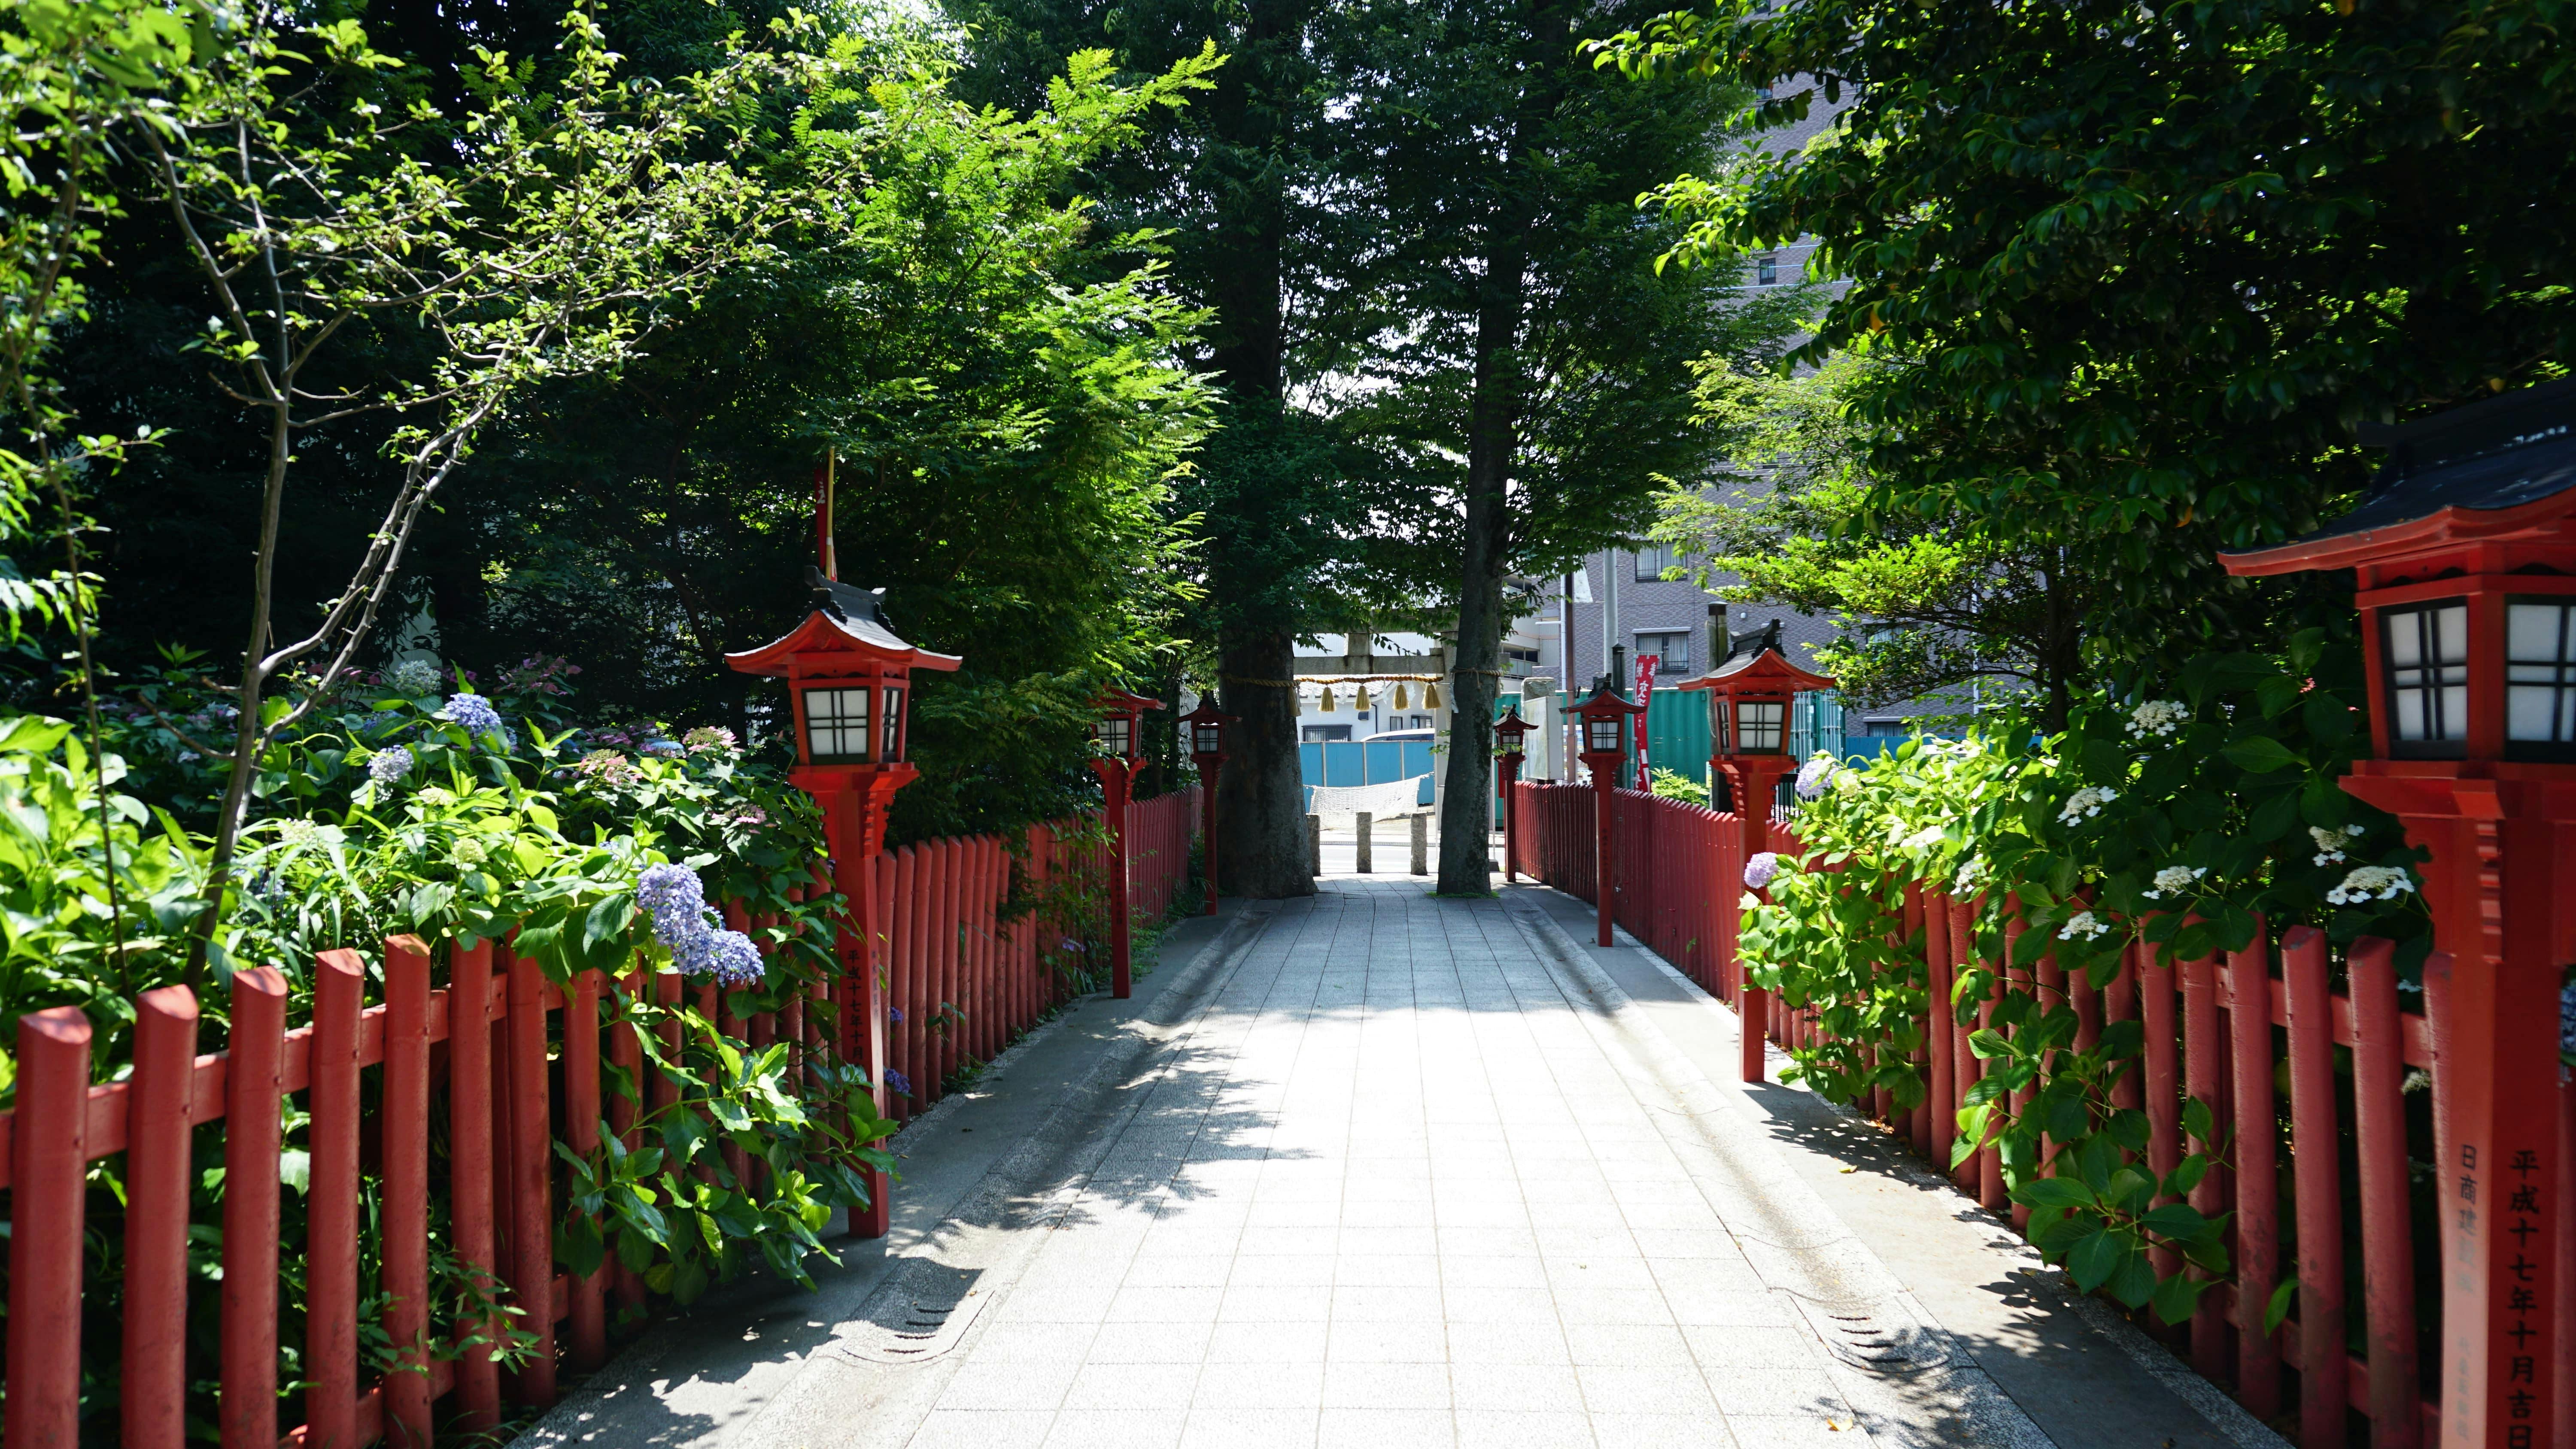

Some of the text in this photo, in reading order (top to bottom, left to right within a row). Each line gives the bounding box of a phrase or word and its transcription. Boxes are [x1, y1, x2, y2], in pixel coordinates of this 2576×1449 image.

[847, 950, 863, 1090] 平成十七年十月
[2508, 1150, 2540, 1449] 平成十七年十月吉日
